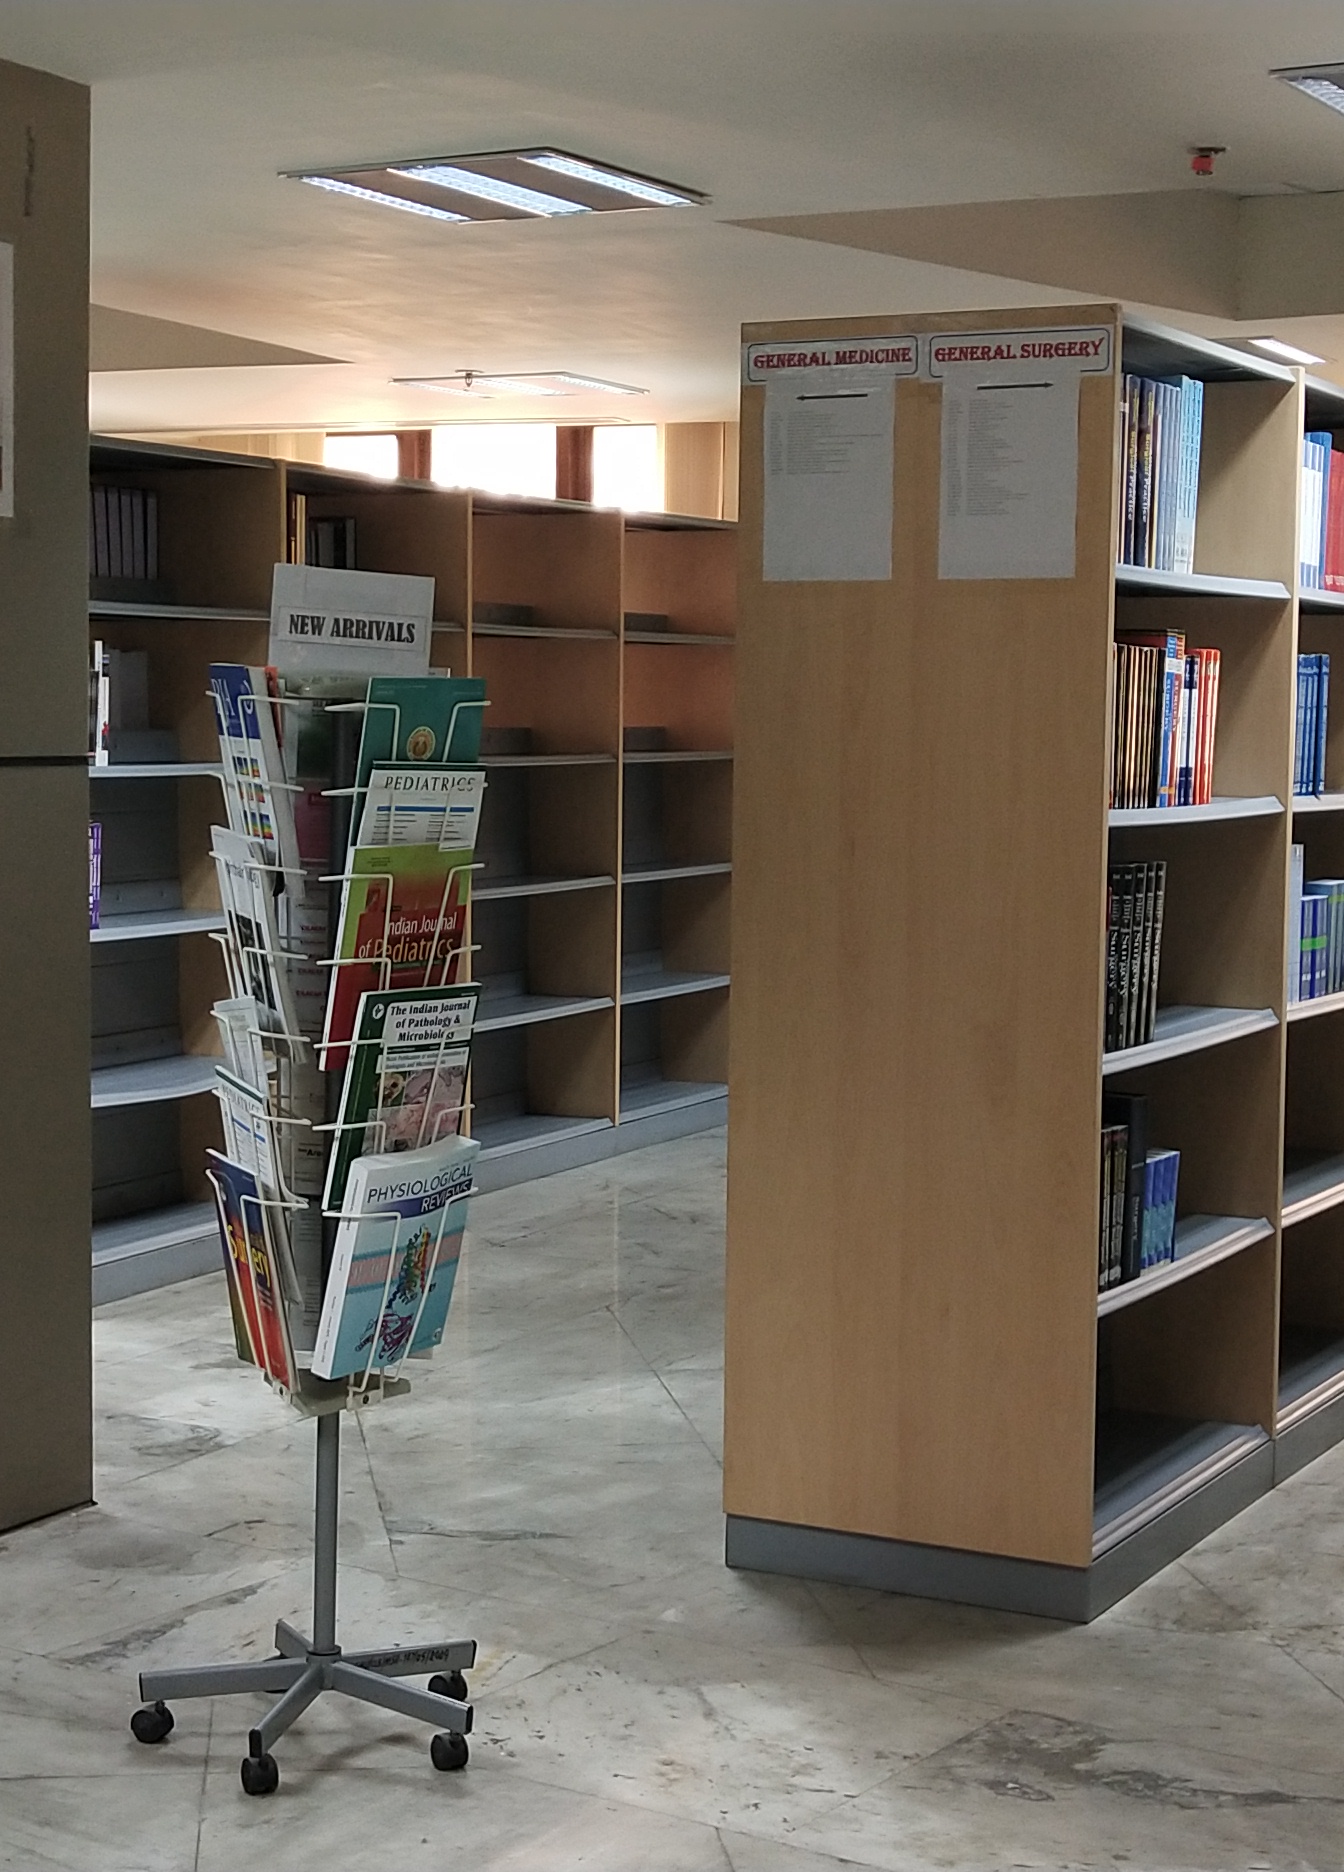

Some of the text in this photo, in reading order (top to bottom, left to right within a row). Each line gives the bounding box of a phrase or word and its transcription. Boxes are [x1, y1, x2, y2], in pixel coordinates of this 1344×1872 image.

[753, 347, 913, 370] GENERAL MEDICINE
[934, 337, 1106, 363] GENERAL SURGERY
[288, 613, 416, 644] NEW ARRIVALS
[383, 775, 476, 793] PEDIATRICS
[386, 911, 458, 936] ndian Jounal
[358, 935, 455, 963] of Pediatrcs
[390, 1000, 472, 1016] The Indian Journal
[395, 1014, 461, 1029] of Pathology &
[367, 1163, 473, 1204] PHYSIOLOGICAL
[420, 1181, 470, 1213] REVIEWS
